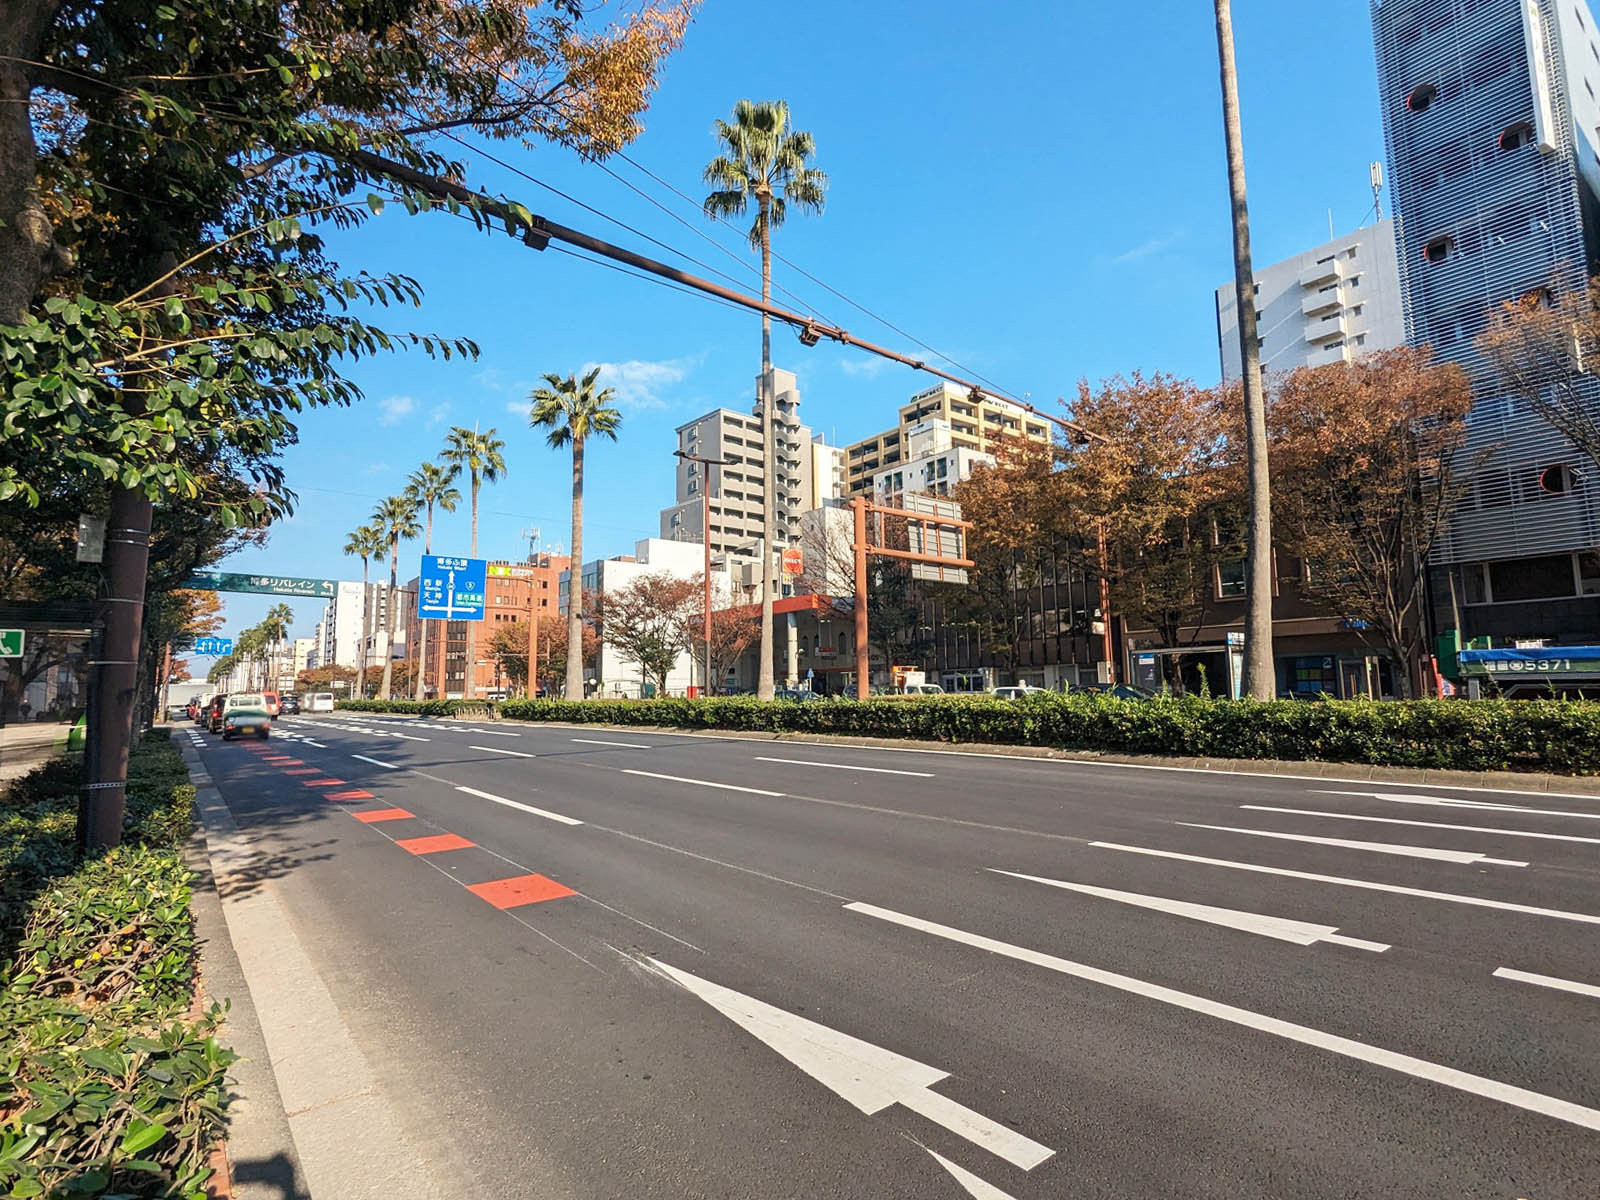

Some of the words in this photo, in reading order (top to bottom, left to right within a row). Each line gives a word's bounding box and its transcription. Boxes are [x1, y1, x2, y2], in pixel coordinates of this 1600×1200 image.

[250, 577, 315, 588] 博多リバレイン
[1525, 659, 1570, 671] 5371
